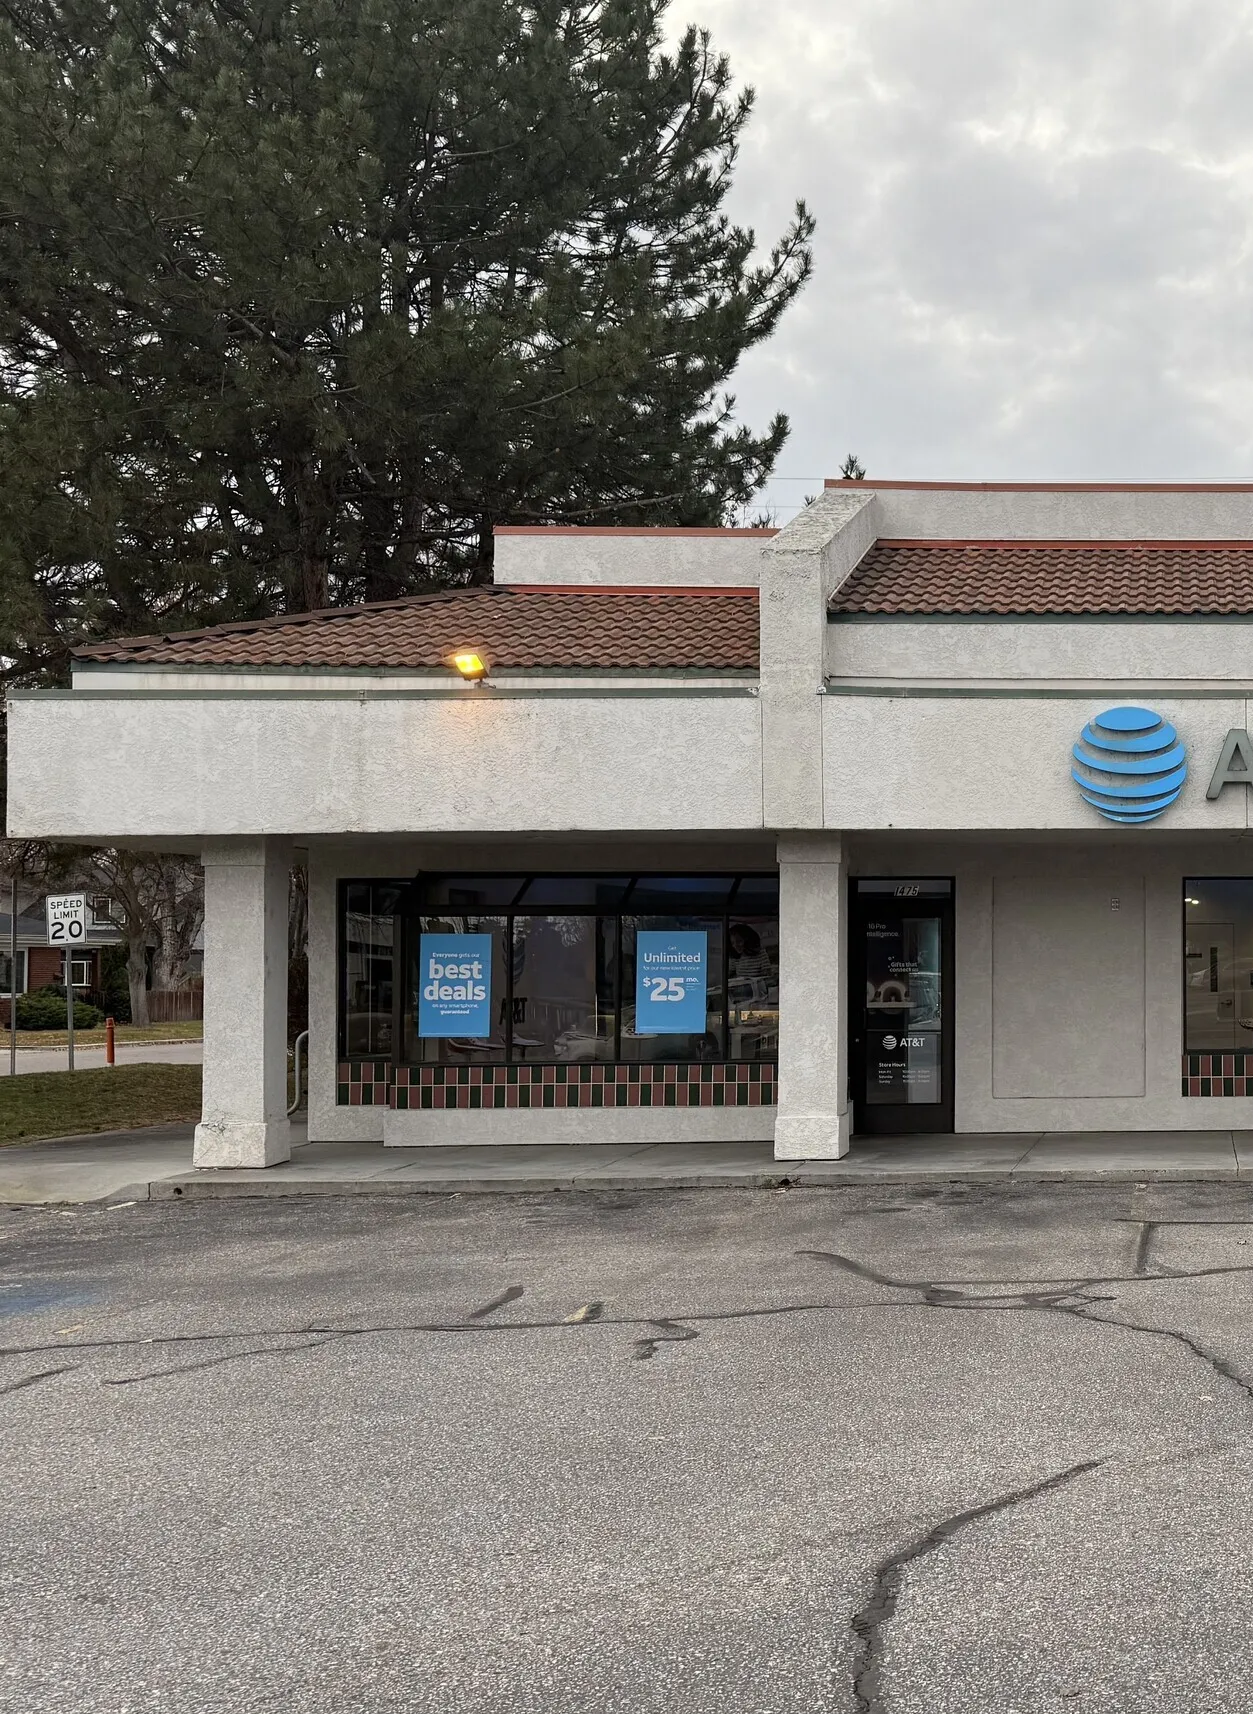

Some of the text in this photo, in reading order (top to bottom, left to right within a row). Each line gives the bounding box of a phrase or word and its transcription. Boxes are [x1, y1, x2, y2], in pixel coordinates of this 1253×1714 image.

[894, 885, 920, 897] 1475
[50, 900, 83, 909] SPEED
[53, 910, 79, 920] LIMIT
[51, 920, 83, 940] 20
[644, 952, 701, 963] Unlimited
[429, 958, 483, 979] best
[424, 980, 486, 1001] deals
[643, 976, 685, 1002] $25
[499, 997, 527, 1025] A&T
[900, 1037, 926, 1047] AT&T
